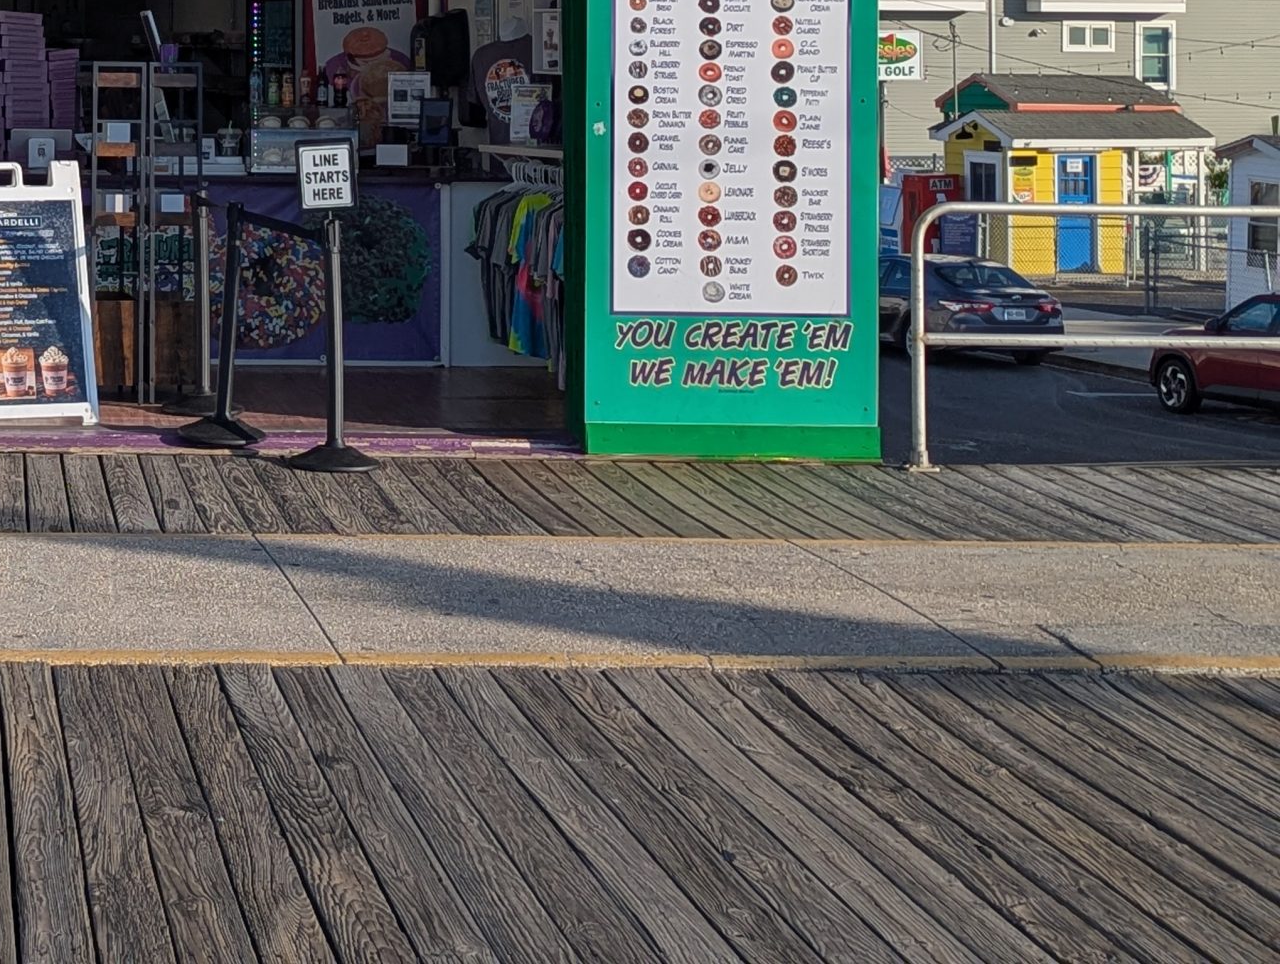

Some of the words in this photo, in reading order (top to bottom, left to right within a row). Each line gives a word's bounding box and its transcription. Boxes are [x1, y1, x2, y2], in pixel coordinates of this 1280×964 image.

[332, 11, 365, 25] Bagels,
[367, 9, 375, 22] &
[376, 7, 401, 22] More!
[653, 17, 674, 25] BLACK
[726, 23, 744, 32] DIRT
[725, 40, 758, 48] ESPRESSO
[884, 66, 915, 77] GOLF
[653, 86, 679, 94] BOSTON
[726, 86, 747, 95] FRIED
[726, 96, 747, 105] OREO
[800, 114, 821, 122] PLAIN
[800, 123, 821, 131] JANE
[802, 139, 831, 149] REESE'S
[728, 145, 745, 154] CAKE
[312, 153, 339, 167] LINE
[722, 163, 748, 174] JELLY
[305, 170, 349, 184] STARTS
[931, 179, 952, 189] ATM
[312, 187, 344, 201] HERE
[725, 236, 749, 245] M&M
[655, 257, 681, 265] COTTON
[657, 267, 679, 275] CANDY
[729, 266, 748, 275] BUNS
[802, 271, 825, 280] TWIX
[728, 292, 752, 300] CREAM
[615, 318, 676, 351] YOU
[684, 318, 795, 352] CREATE
[802, 320, 853, 352] 'EM
[629, 357, 675, 386] WE
[681, 357, 770, 388] MAKE
[774, 357, 838, 390] 'EM!
